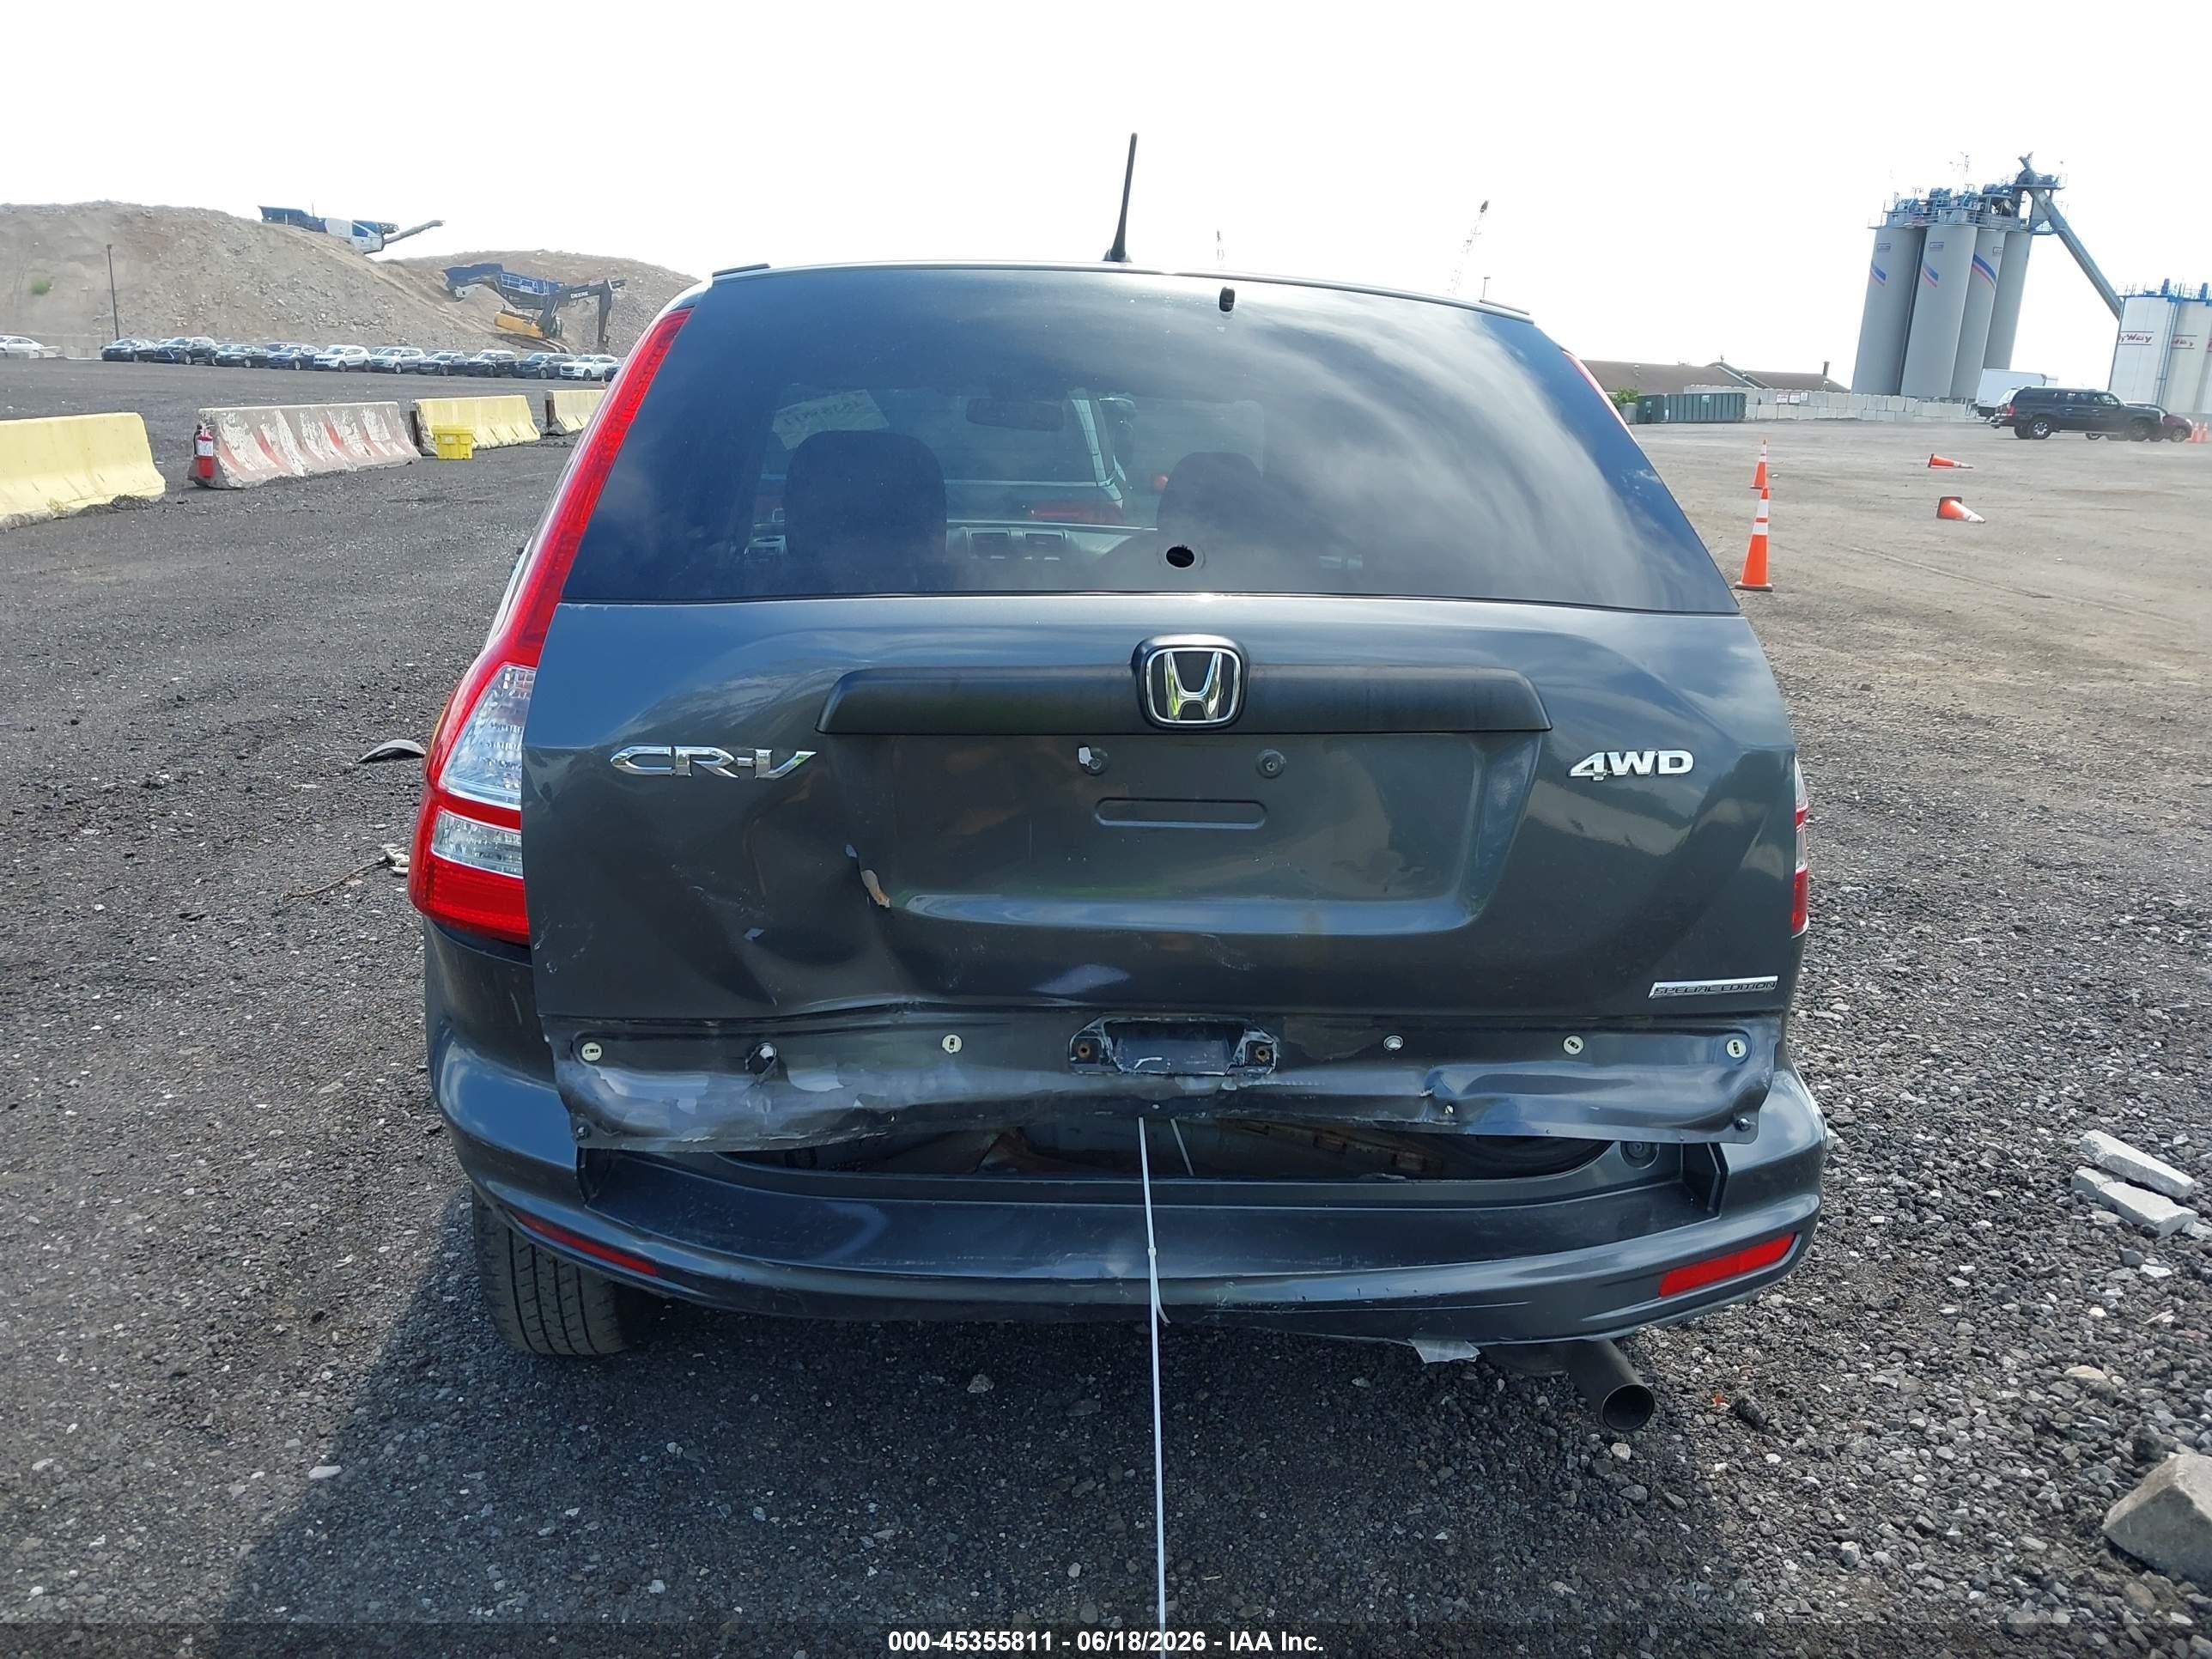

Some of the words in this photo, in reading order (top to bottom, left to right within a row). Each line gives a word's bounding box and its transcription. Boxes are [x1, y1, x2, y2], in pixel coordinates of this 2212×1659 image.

[610, 744, 817, 780] CR-V
[1568, 749, 1694, 781] 4WD
[1654, 986, 1716, 995] SPECIAL
[1721, 981, 1777, 992] EDITION
